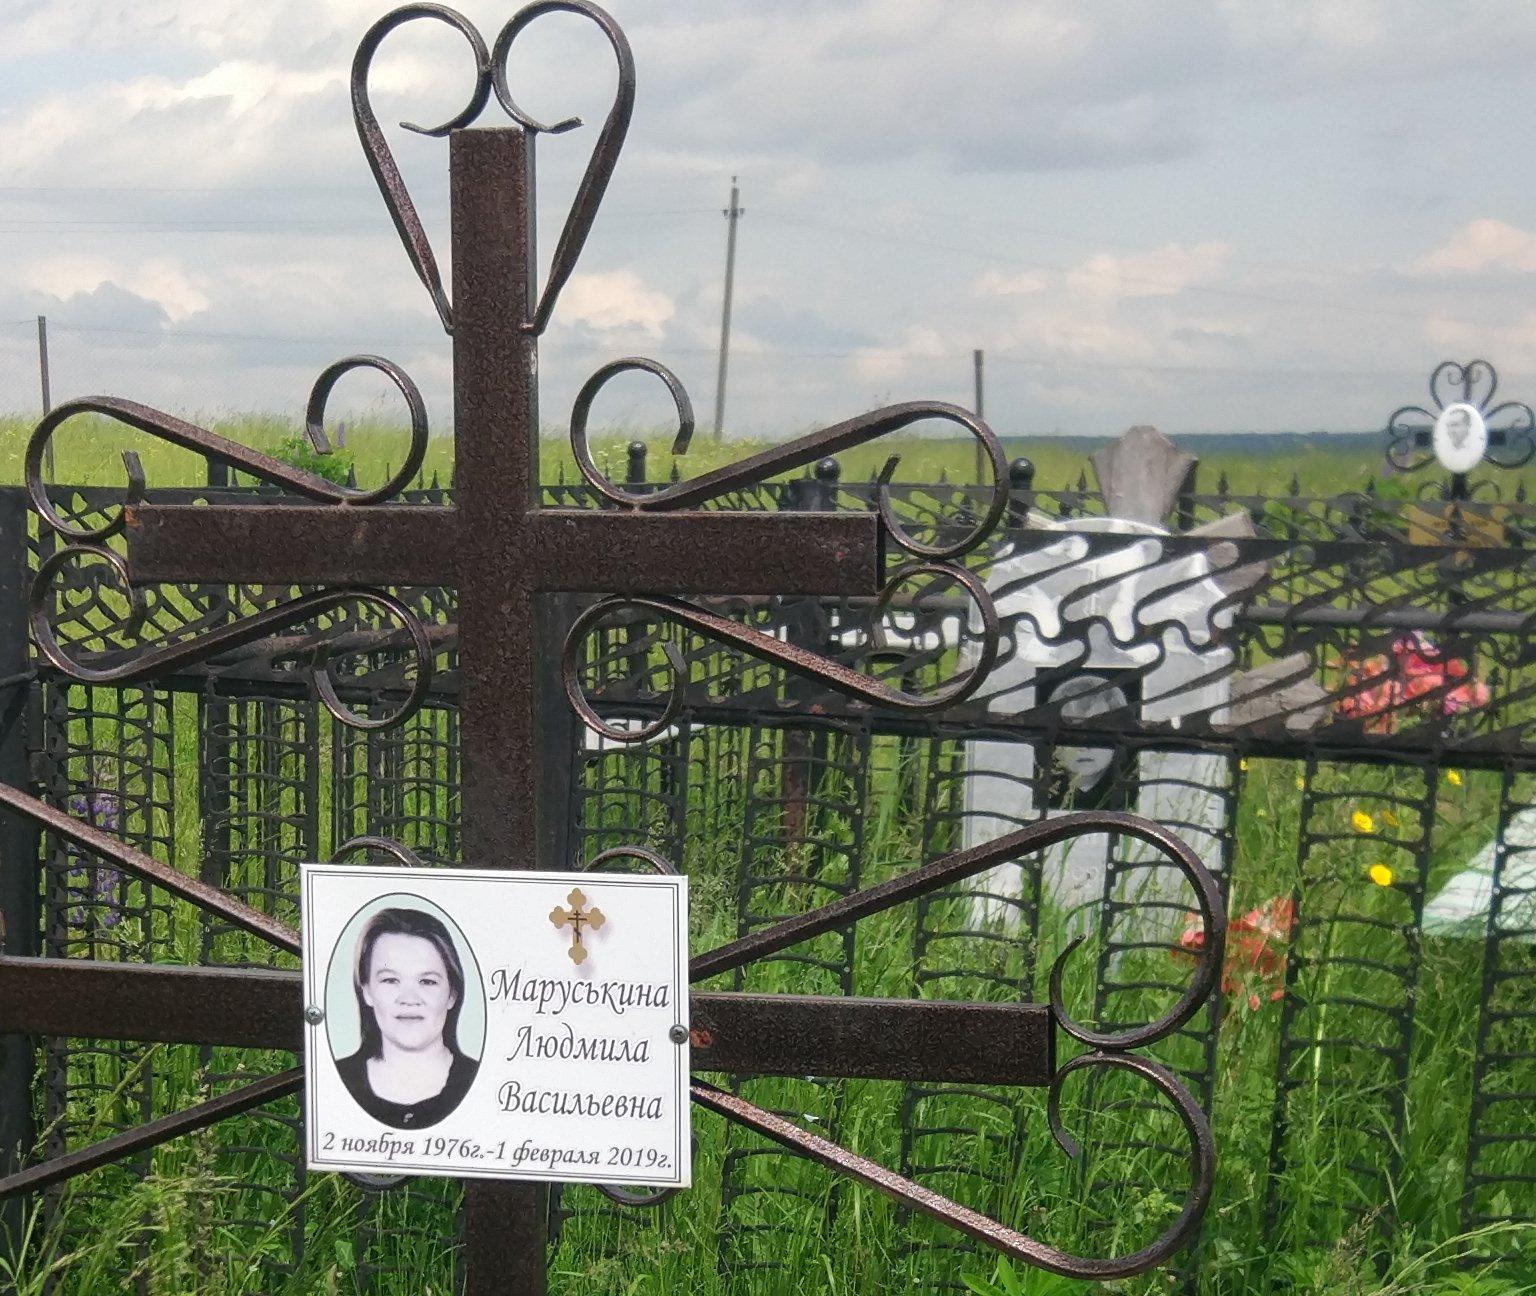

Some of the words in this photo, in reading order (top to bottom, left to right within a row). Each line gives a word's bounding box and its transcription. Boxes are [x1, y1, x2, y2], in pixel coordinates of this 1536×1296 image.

[490, 968, 670, 1015] Маруськина
[507, 1022, 650, 1063] Людмила
[498, 1081, 663, 1120] Васильевна
[323, 1132, 336, 1151] 2
[341, 1134, 416, 1160] ноября
[511, 1140, 600, 1169] февраля
[607, 1146, 673, 1169] 2019г.
